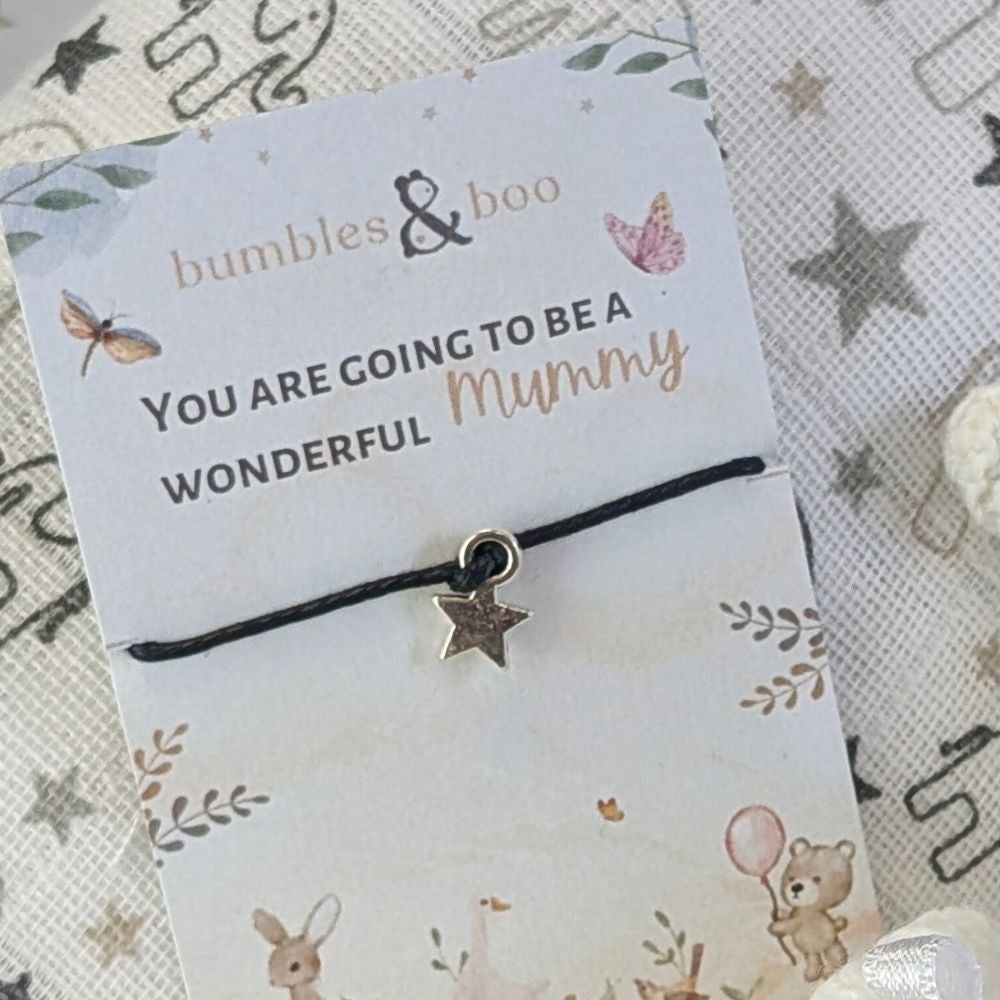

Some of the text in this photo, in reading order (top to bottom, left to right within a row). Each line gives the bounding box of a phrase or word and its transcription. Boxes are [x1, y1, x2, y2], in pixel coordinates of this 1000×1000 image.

[171, 169, 561, 289] bumbles & boo
[140, 291, 632, 433] YOU ARE GOING TO BE A
[160, 416, 431, 504] WONDERFUL
